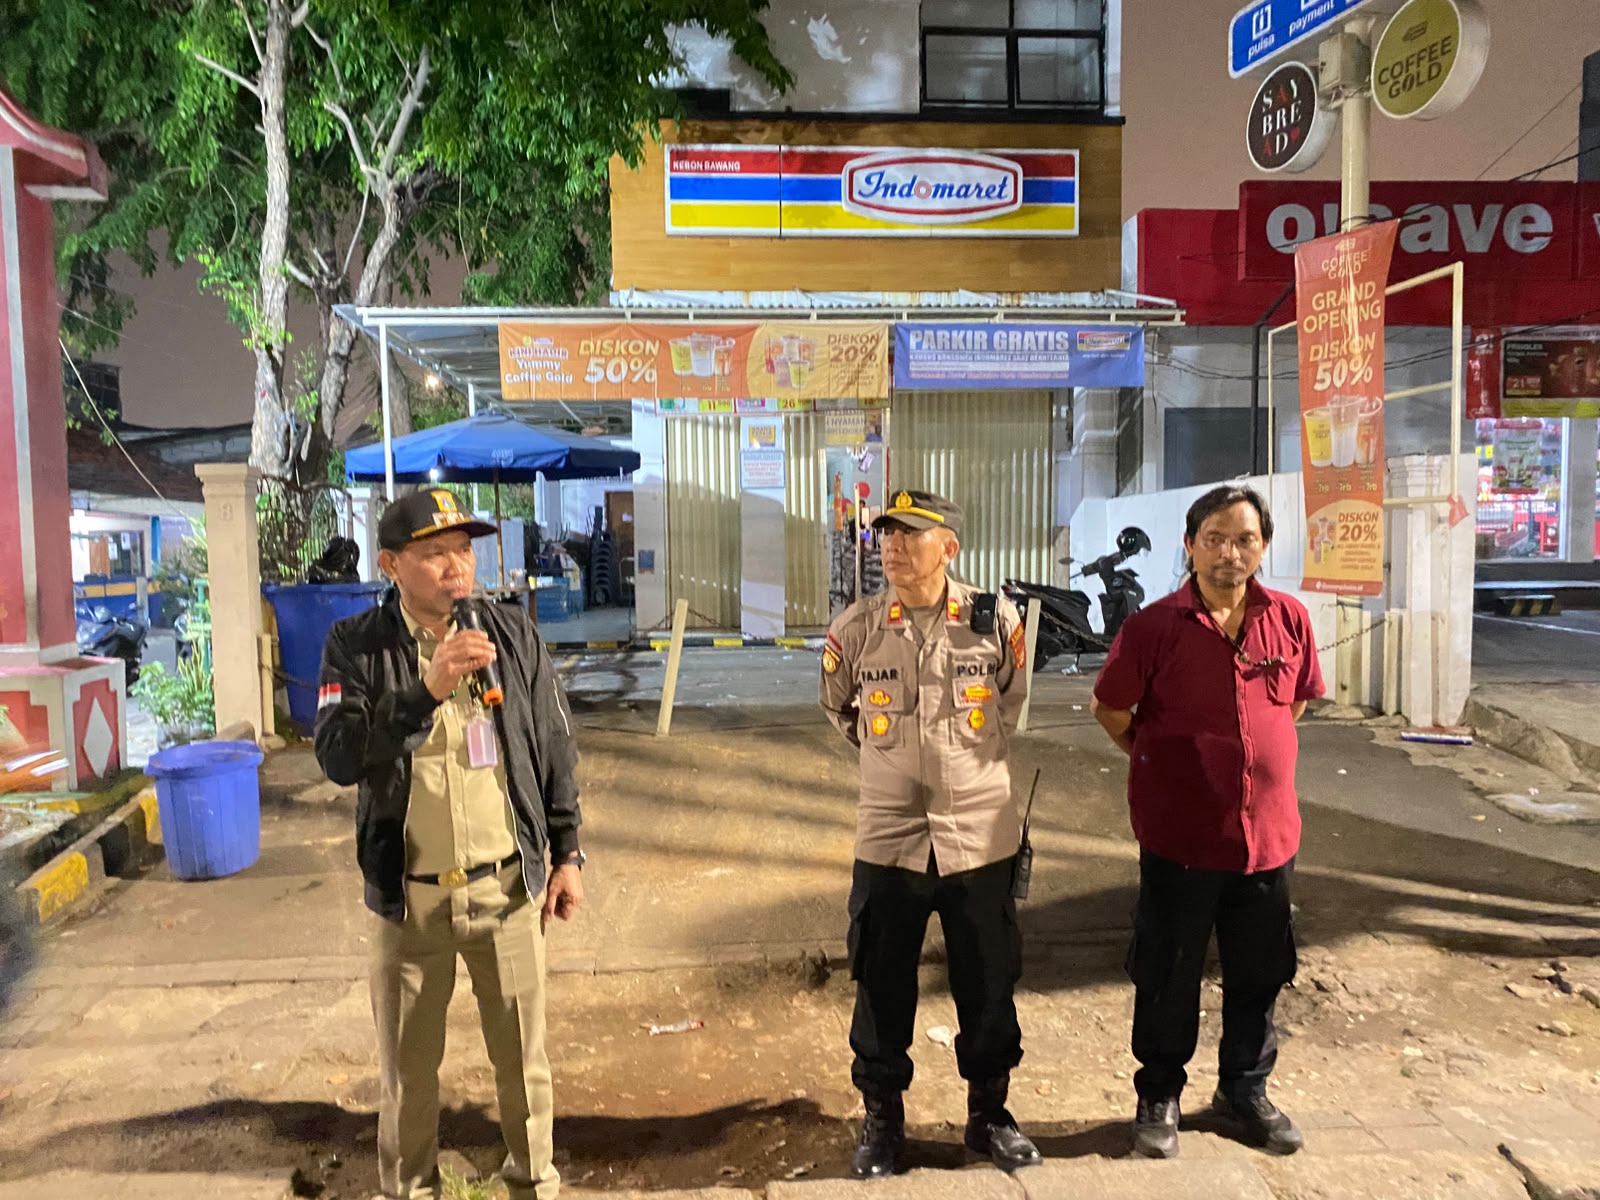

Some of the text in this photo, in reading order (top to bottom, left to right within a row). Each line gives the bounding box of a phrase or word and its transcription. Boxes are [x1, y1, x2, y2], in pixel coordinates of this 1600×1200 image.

[1289, 0, 1335, 37] payment
[1248, 34, 1275, 61] pulsa
[1378, 36, 1452, 86] COFFEE
[1388, 62, 1442, 99] GOLD
[1262, 77, 1299, 113] SAY
[1262, 100, 1302, 136] BRE
[673, 160, 740, 171] KEBON BAWANG
[857, 169, 1010, 199] Indomaret
[1266, 203, 1553, 253] o!ave
[1322, 250, 1368, 272] COFFEE
[1312, 281, 1376, 311] GRAND
[578, 339, 660, 356] DISKON
[827, 333, 880, 345] DISKON
[909, 330, 988, 351] PARKIR
[993, 330, 1069, 351] GRATIS
[1309, 332, 1375, 361] DISKON
[516, 359, 561, 371] Yummy
[830, 344, 878, 362] 20%
[505, 371, 573, 384] Coffee Gold
[583, 357, 658, 384] 50%
[1313, 353, 1373, 391] 50%
[781, 399, 796, 409] 26
[1338, 511, 1379, 523] DISKON
[1339, 523, 1377, 542] 20%
[861, 669, 898, 682] FAJAR
